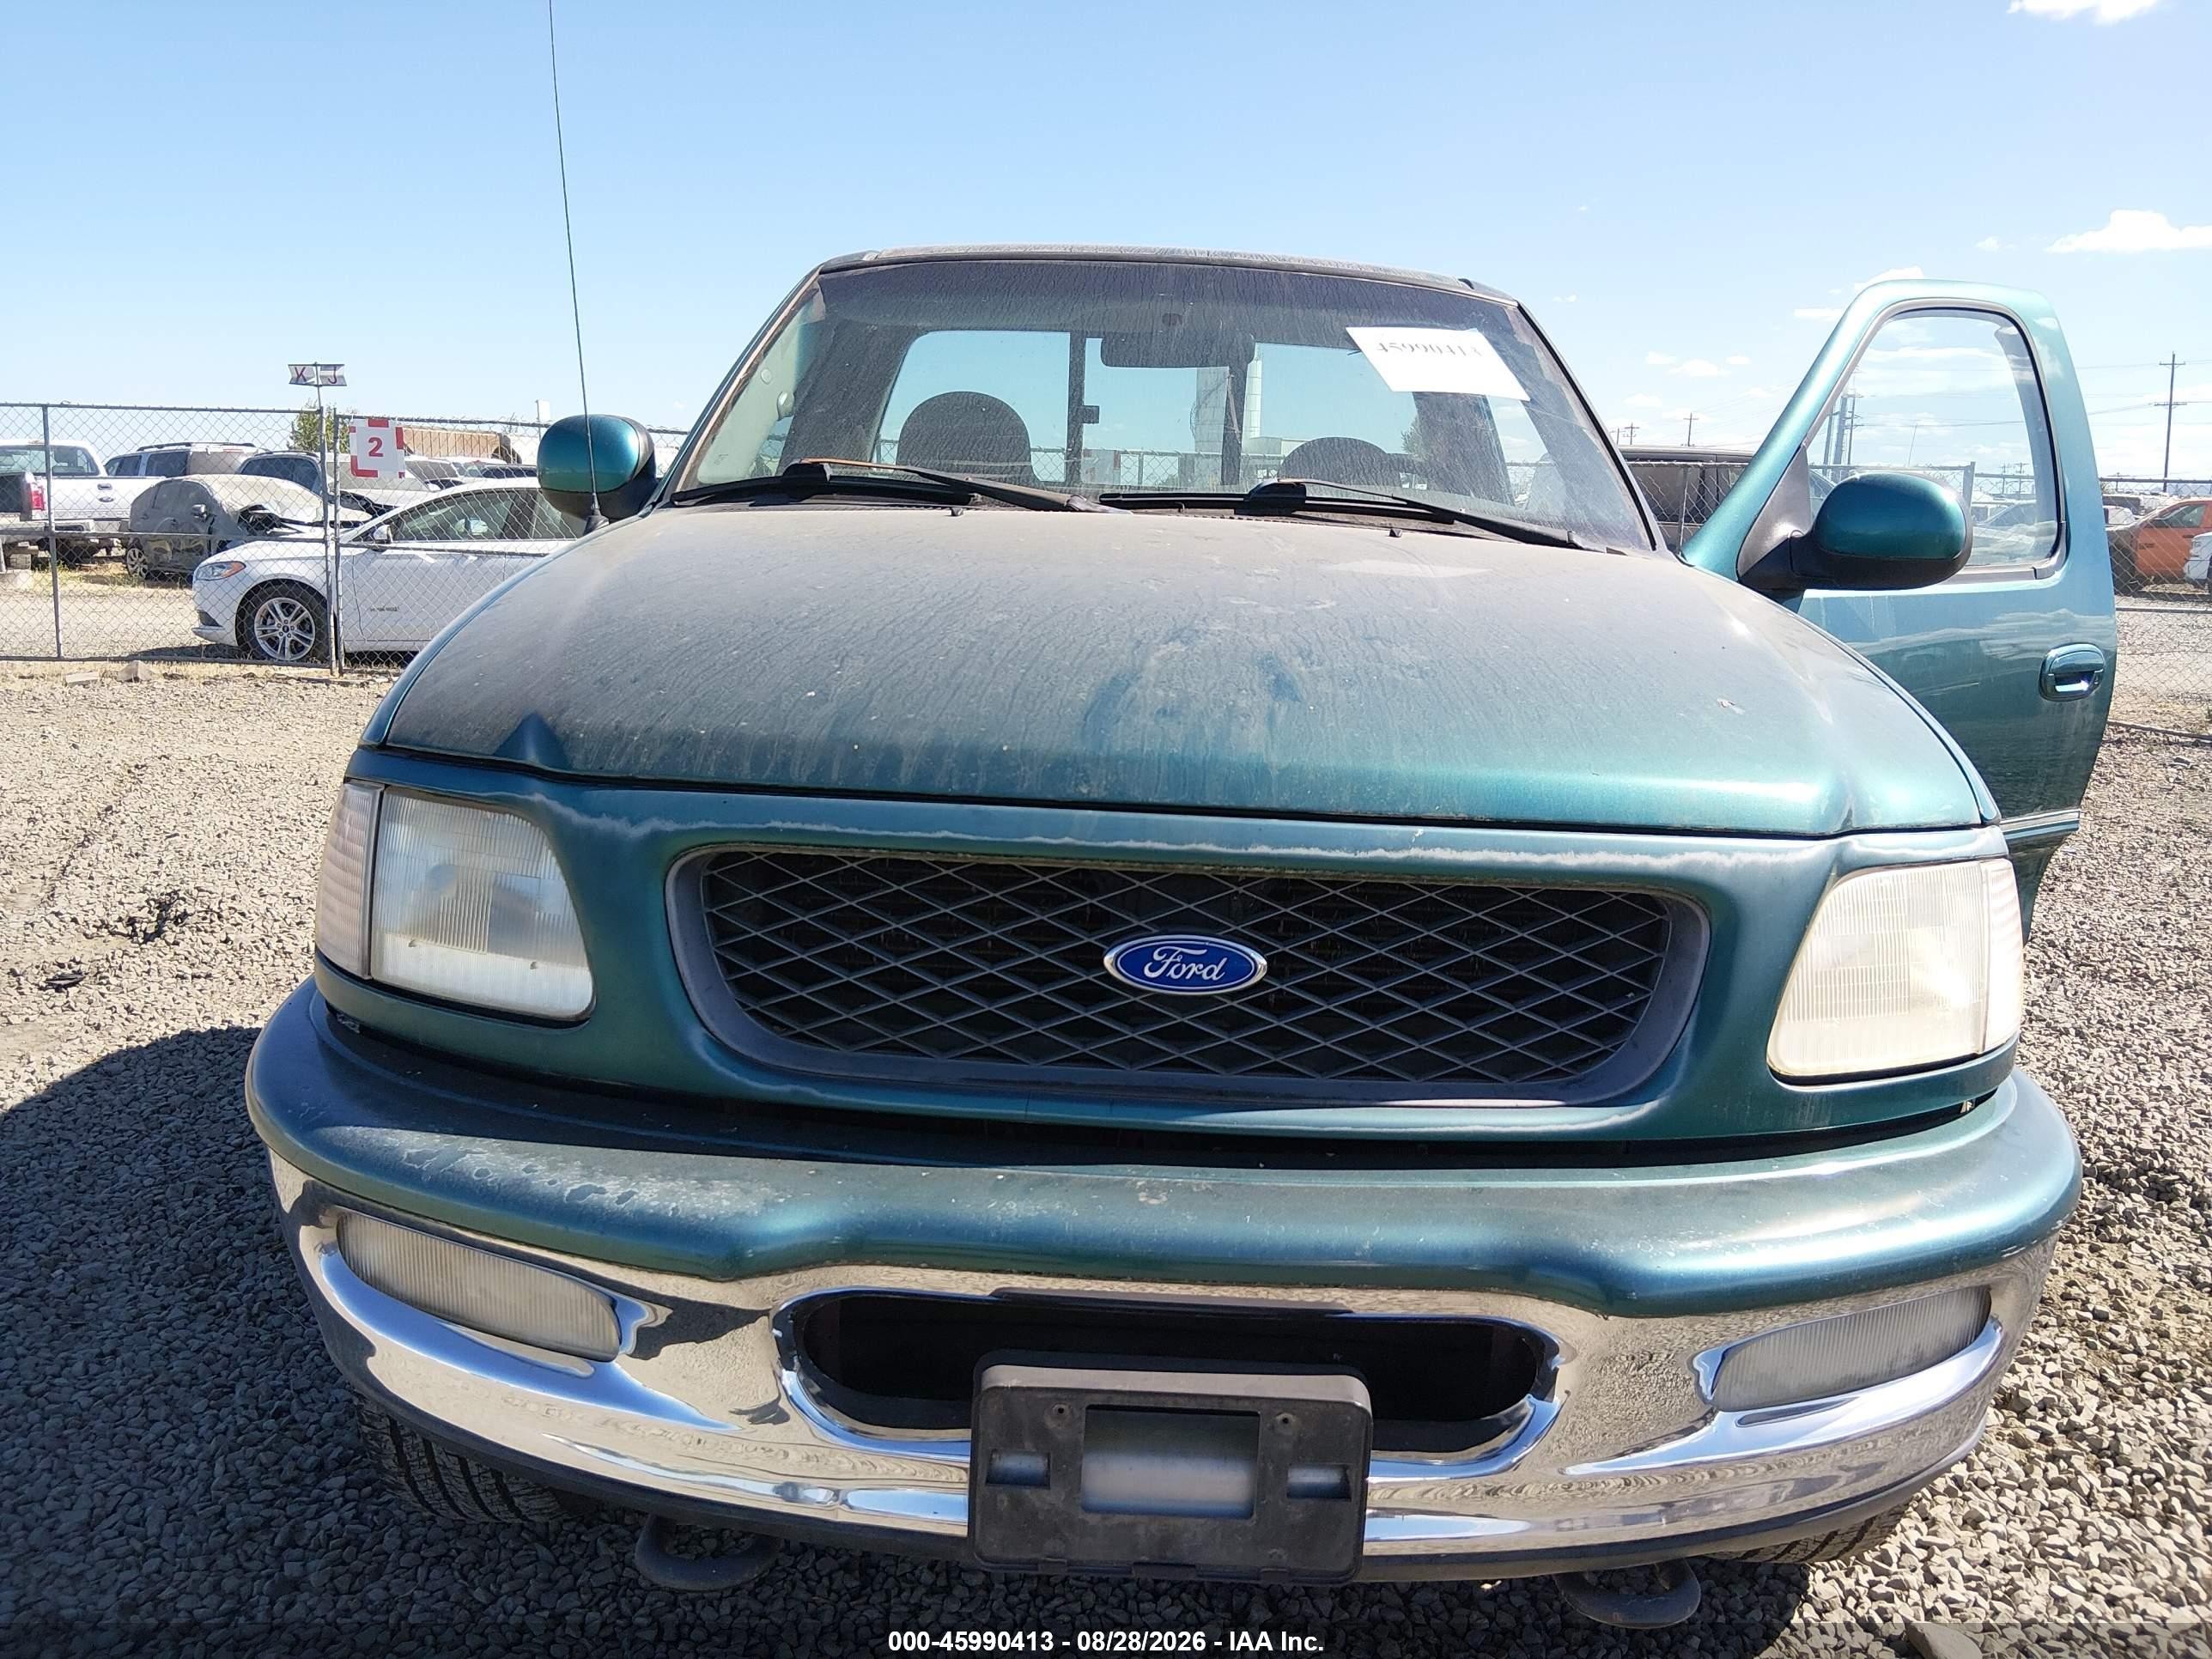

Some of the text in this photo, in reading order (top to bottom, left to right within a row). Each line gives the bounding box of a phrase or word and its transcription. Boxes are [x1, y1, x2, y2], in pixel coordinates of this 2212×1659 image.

[328, 366, 337, 384] J
[368, 436, 384, 458] 2
[1144, 945, 1228, 981] Ford
